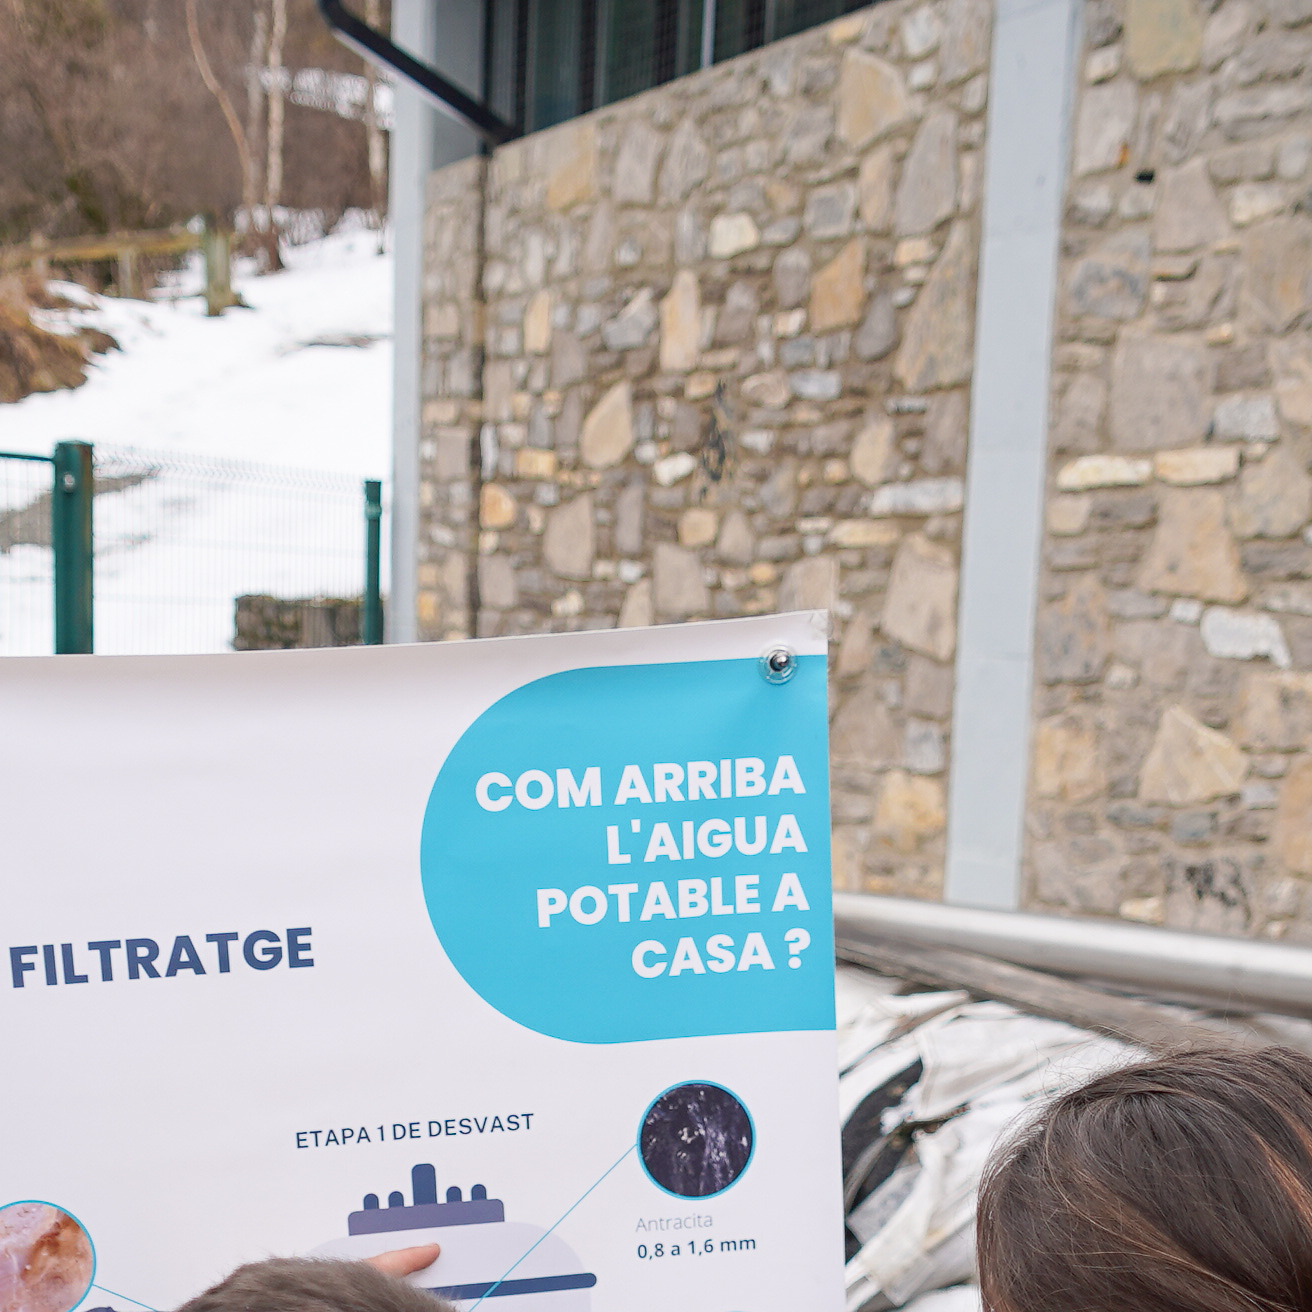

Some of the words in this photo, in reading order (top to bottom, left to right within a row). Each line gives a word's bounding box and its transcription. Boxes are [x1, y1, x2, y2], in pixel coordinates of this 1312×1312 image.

[475, 766, 603, 812] COM
[614, 754, 807, 805] ARRIBA
[606, 813, 809, 865] L'AIGUA
[537, 874, 762, 929] POTABLE
[771, 872, 811, 912] A
[9, 926, 315, 988] FILTRATGE
[631, 931, 776, 979] CASA
[783, 927, 812, 969] ?
[295, 1126, 371, 1149] ETAPA
[377, 1125, 385, 1142] 1
[392, 1121, 421, 1141] DE
[428, 1113, 535, 1138] DESVAST
[635, 1212, 714, 1233] Antracita
[637, 1242, 665, 1260] 0,8
[670, 1244, 681, 1256] a
[687, 1238, 714, 1257] 1,6
[720, 1238, 756, 1252] mm
